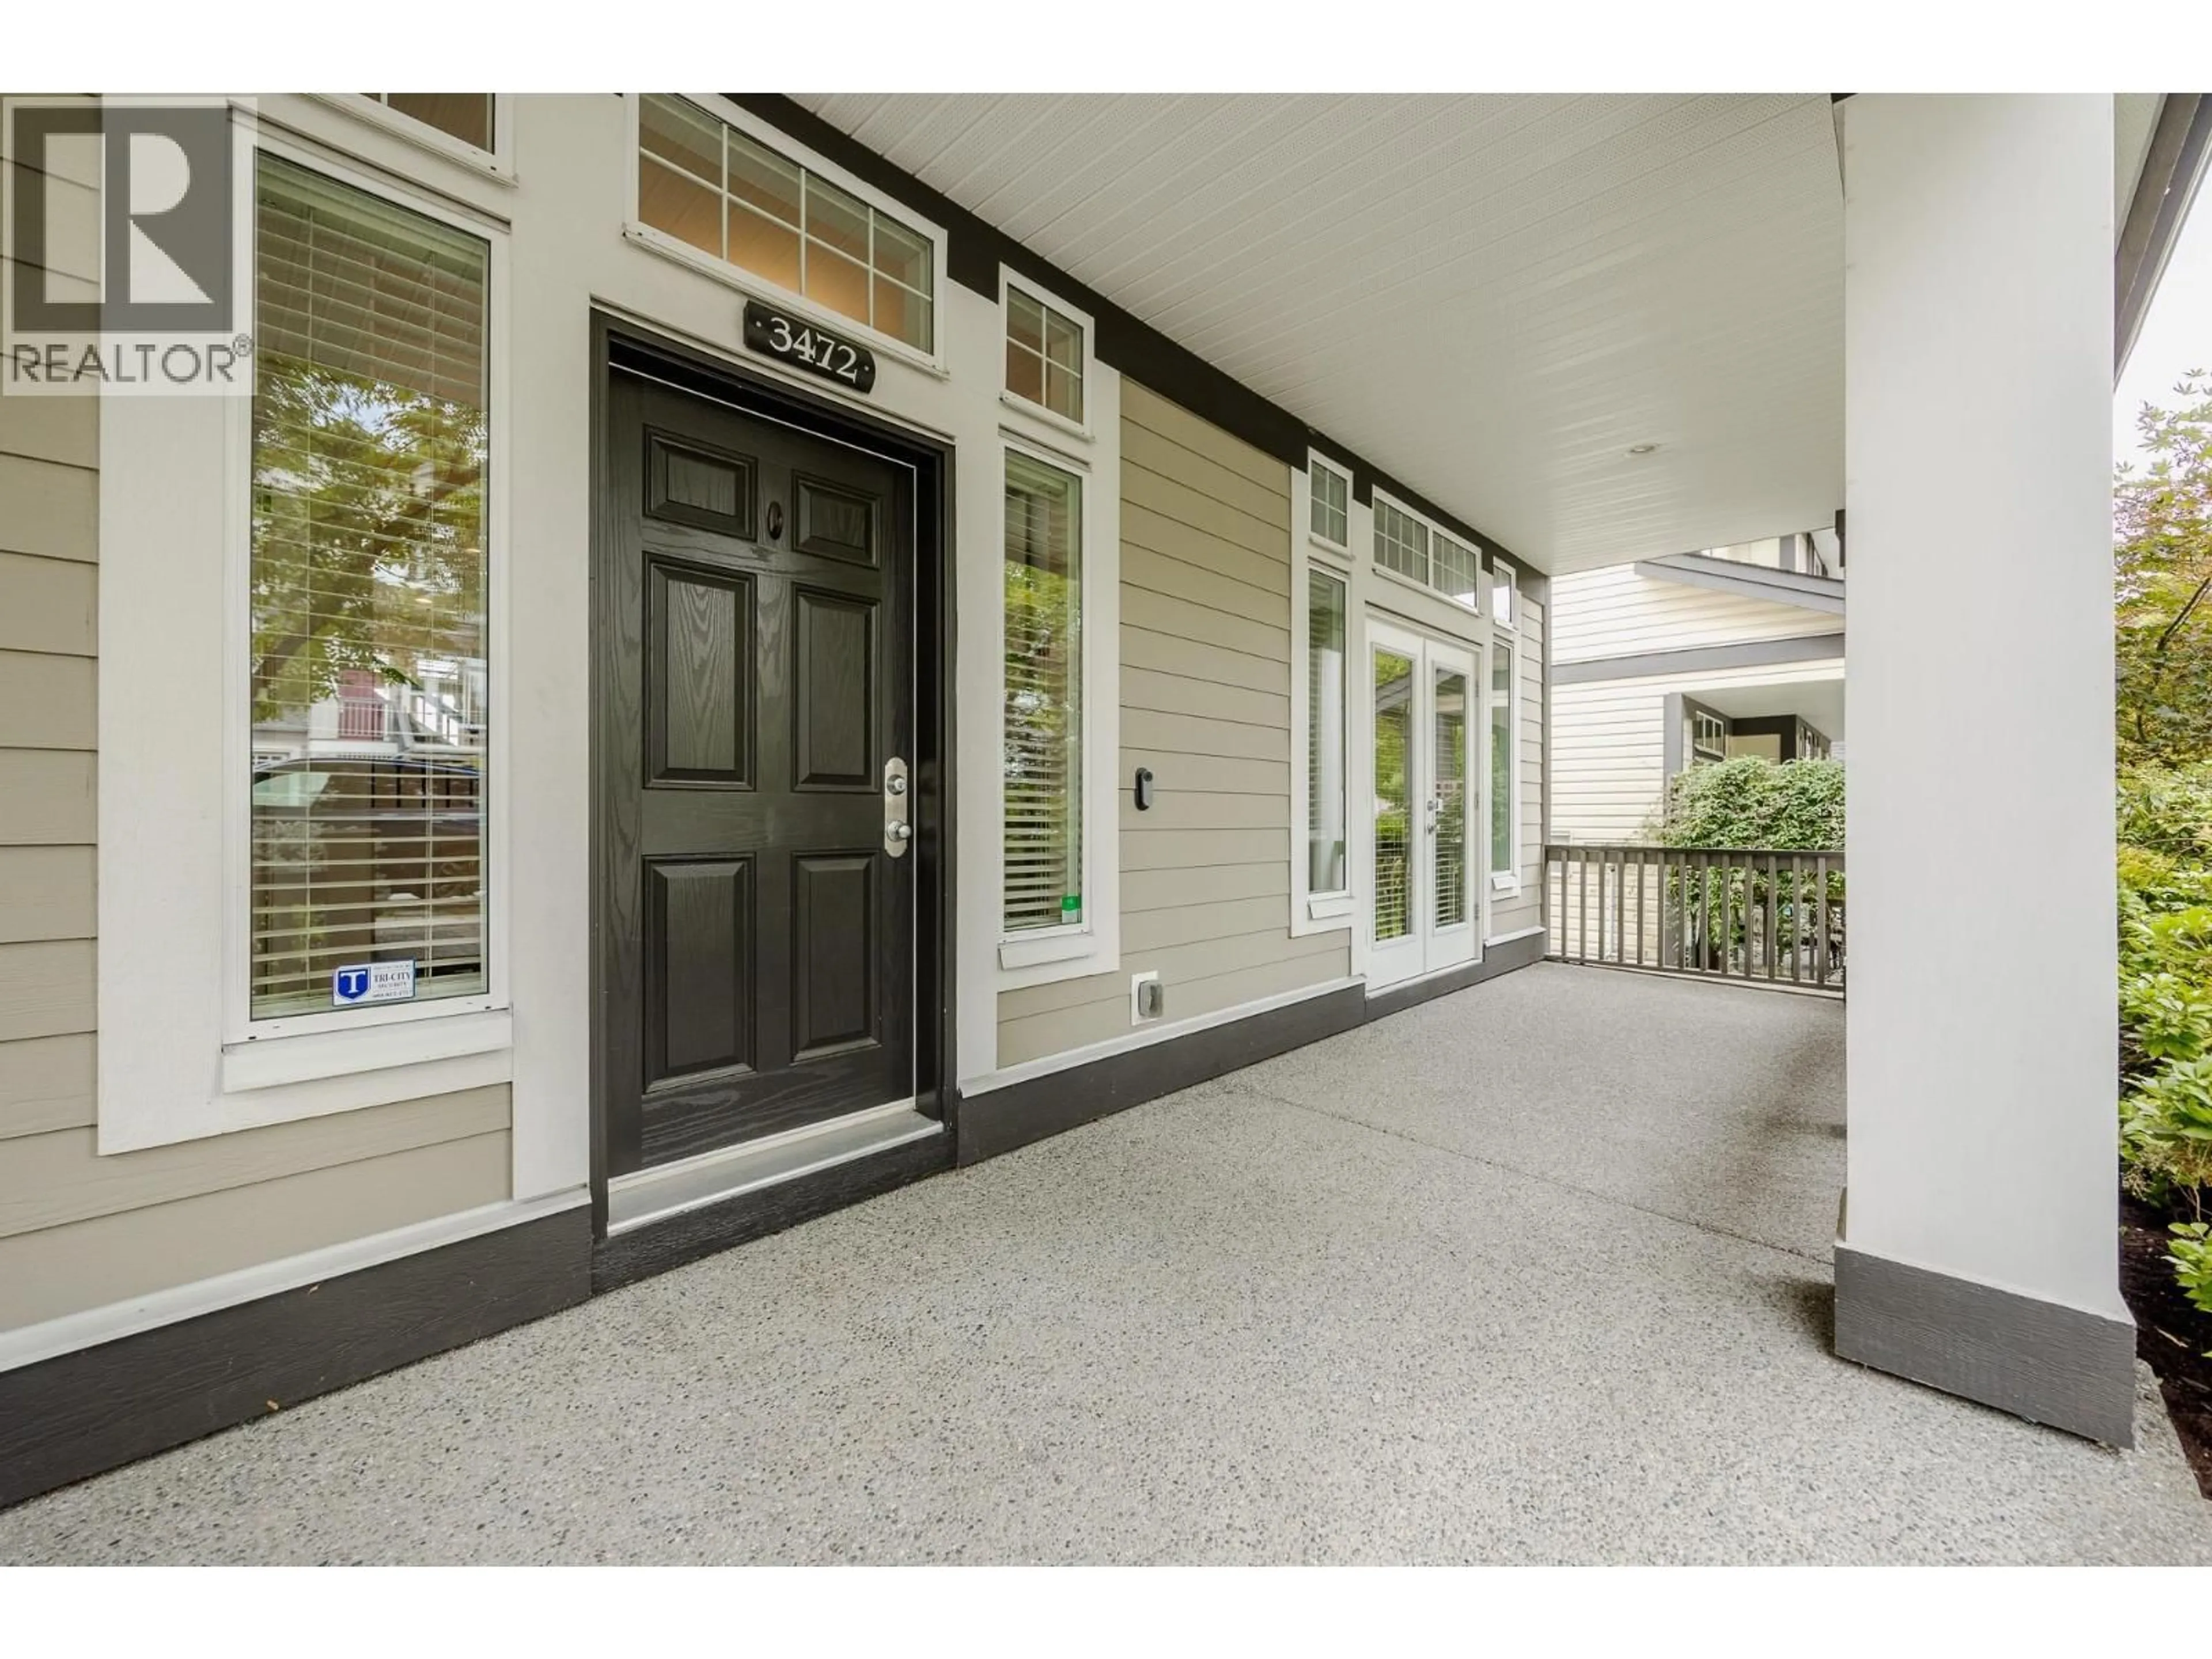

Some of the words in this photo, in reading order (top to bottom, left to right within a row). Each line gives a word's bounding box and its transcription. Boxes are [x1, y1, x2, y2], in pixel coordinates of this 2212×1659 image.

[770, 317, 858, 384] 3472
[340, 971, 366, 994] T
[374, 971, 410, 982] TRI-CITY
